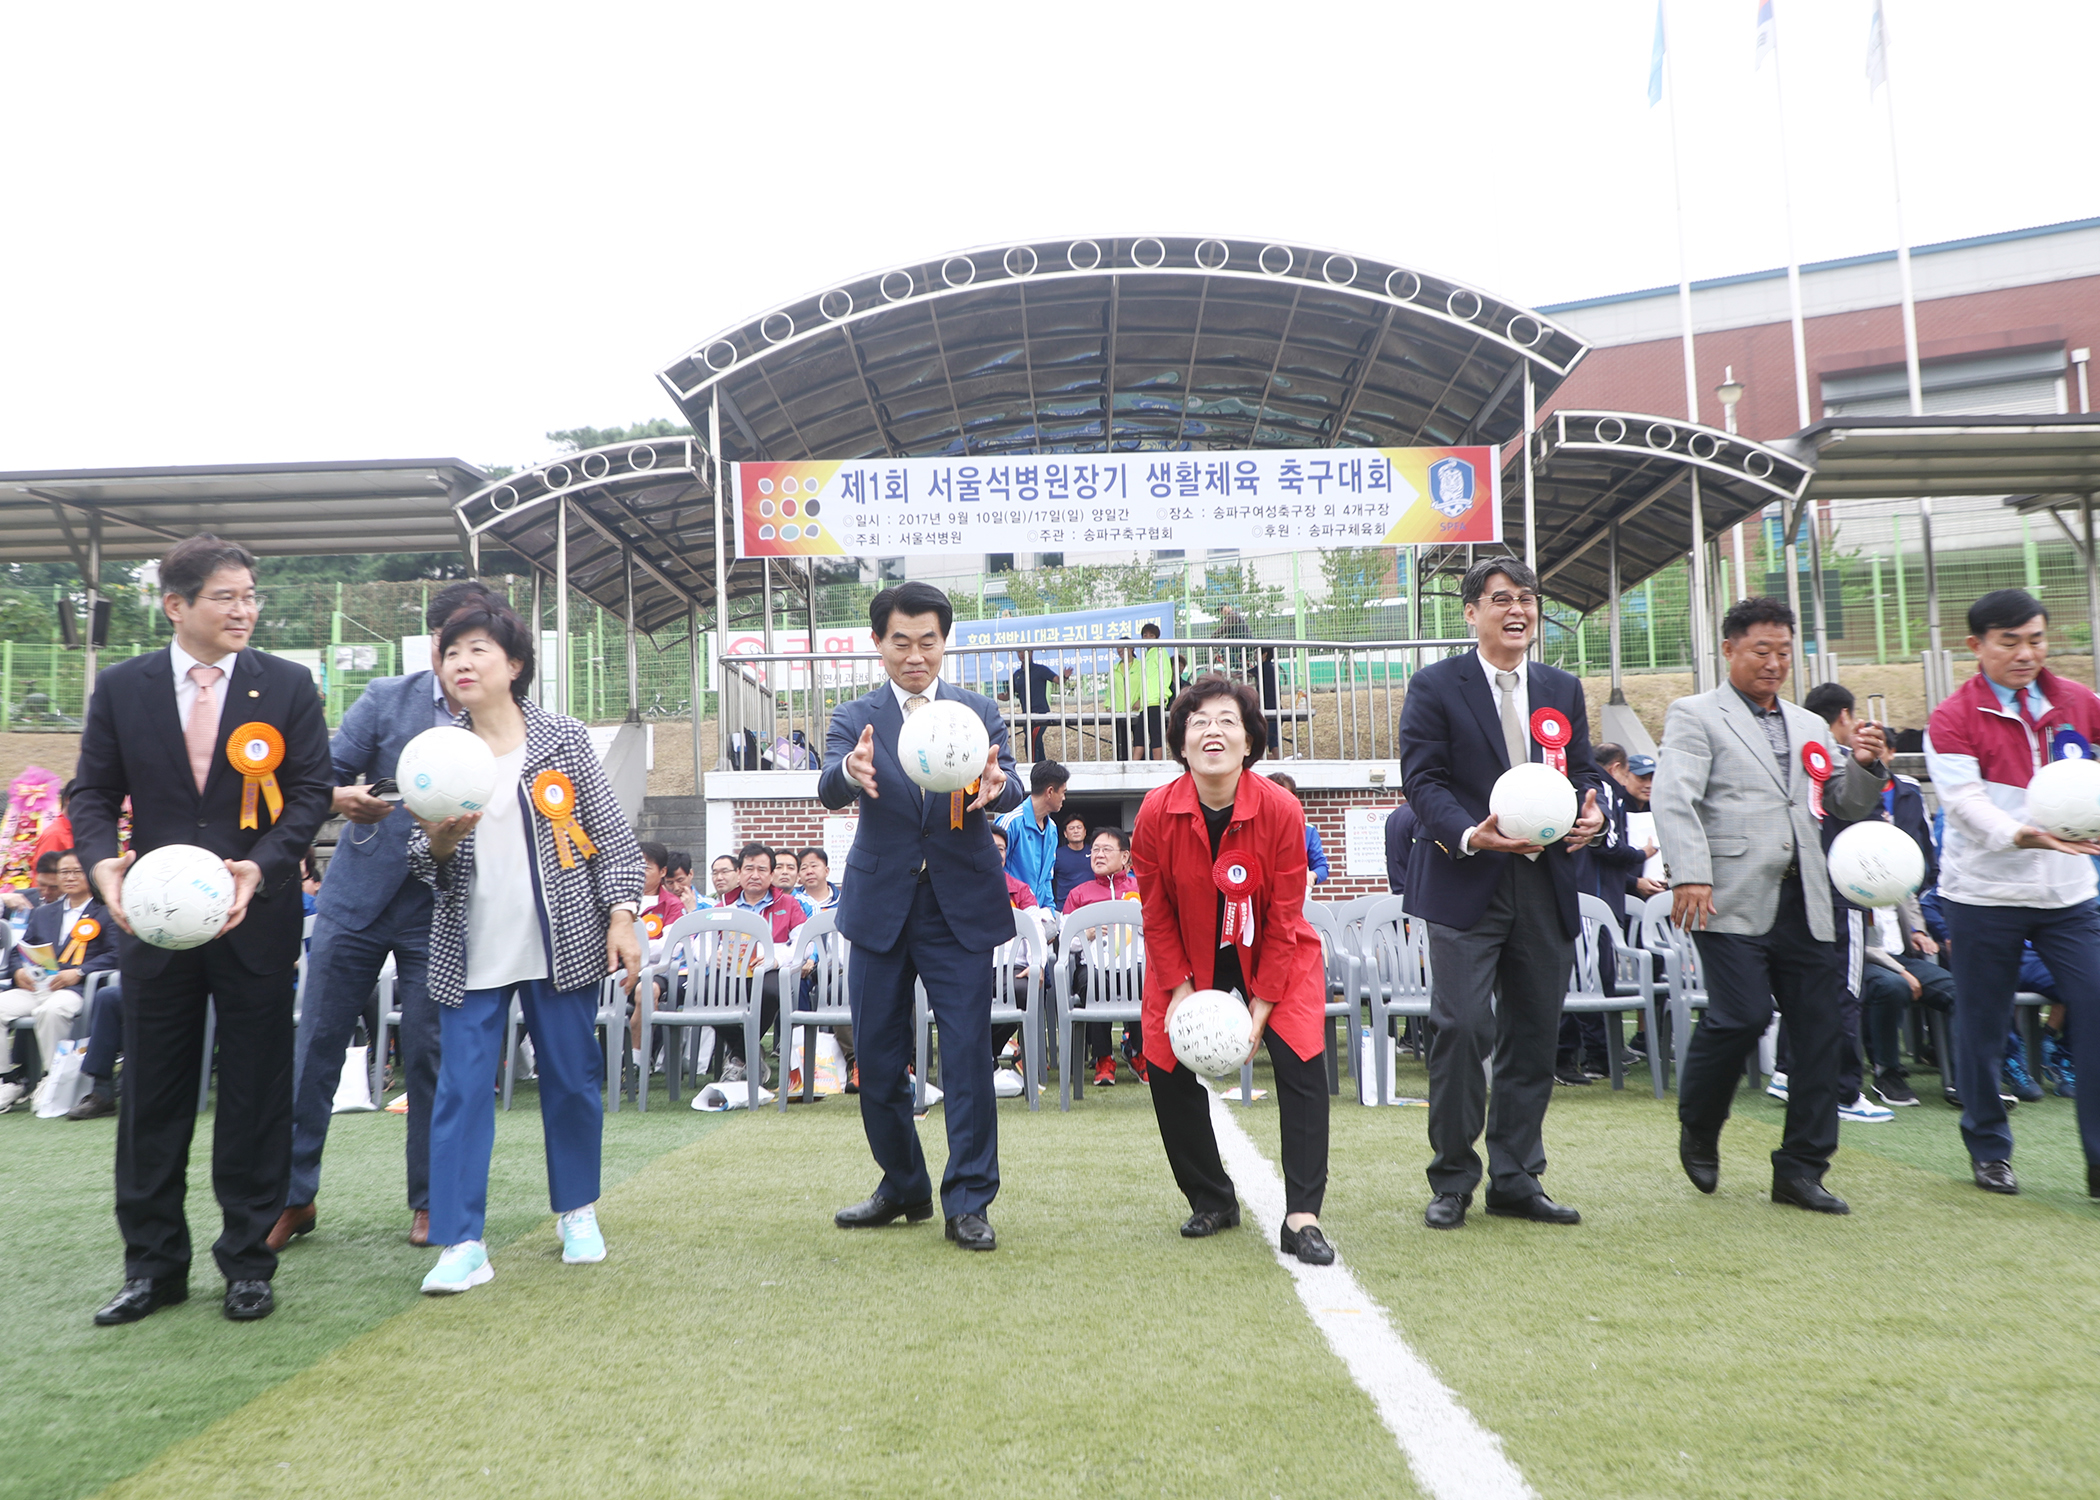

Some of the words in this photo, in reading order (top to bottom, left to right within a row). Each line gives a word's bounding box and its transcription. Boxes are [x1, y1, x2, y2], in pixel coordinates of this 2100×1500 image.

[840, 468, 909, 505] 제1회
[927, 463, 1127, 502] 서울석병원장기
[1146, 460, 1260, 498] 생활체육
[1278, 457, 1391, 495] 축구대회
[855, 514, 880, 527] 일시
[898, 512, 941, 526] 2017년
[948, 511, 969, 525] 9월
[976, 509, 1085, 525] 10일(일)/17일(일)
[1091, 507, 1130, 522] 양일간
[1169, 506, 1194, 520] 장소
[1213, 503, 1317, 519] 송파구여성축구장
[1323, 503, 1336, 517] 외
[1342, 502, 1390, 517] 4개구장
[1039, 529, 1065, 543] 주관
[1083, 526, 1173, 542] 송파구축구협회
[1264, 523, 1290, 538] 후원
[1308, 521, 1386, 538] 송파구체육회
[1440, 521, 1467, 532] SPFA
[855, 532, 880, 547] 주최
[899, 530, 962, 546] 서울석병원
[191, 879, 220, 899] KIKA
